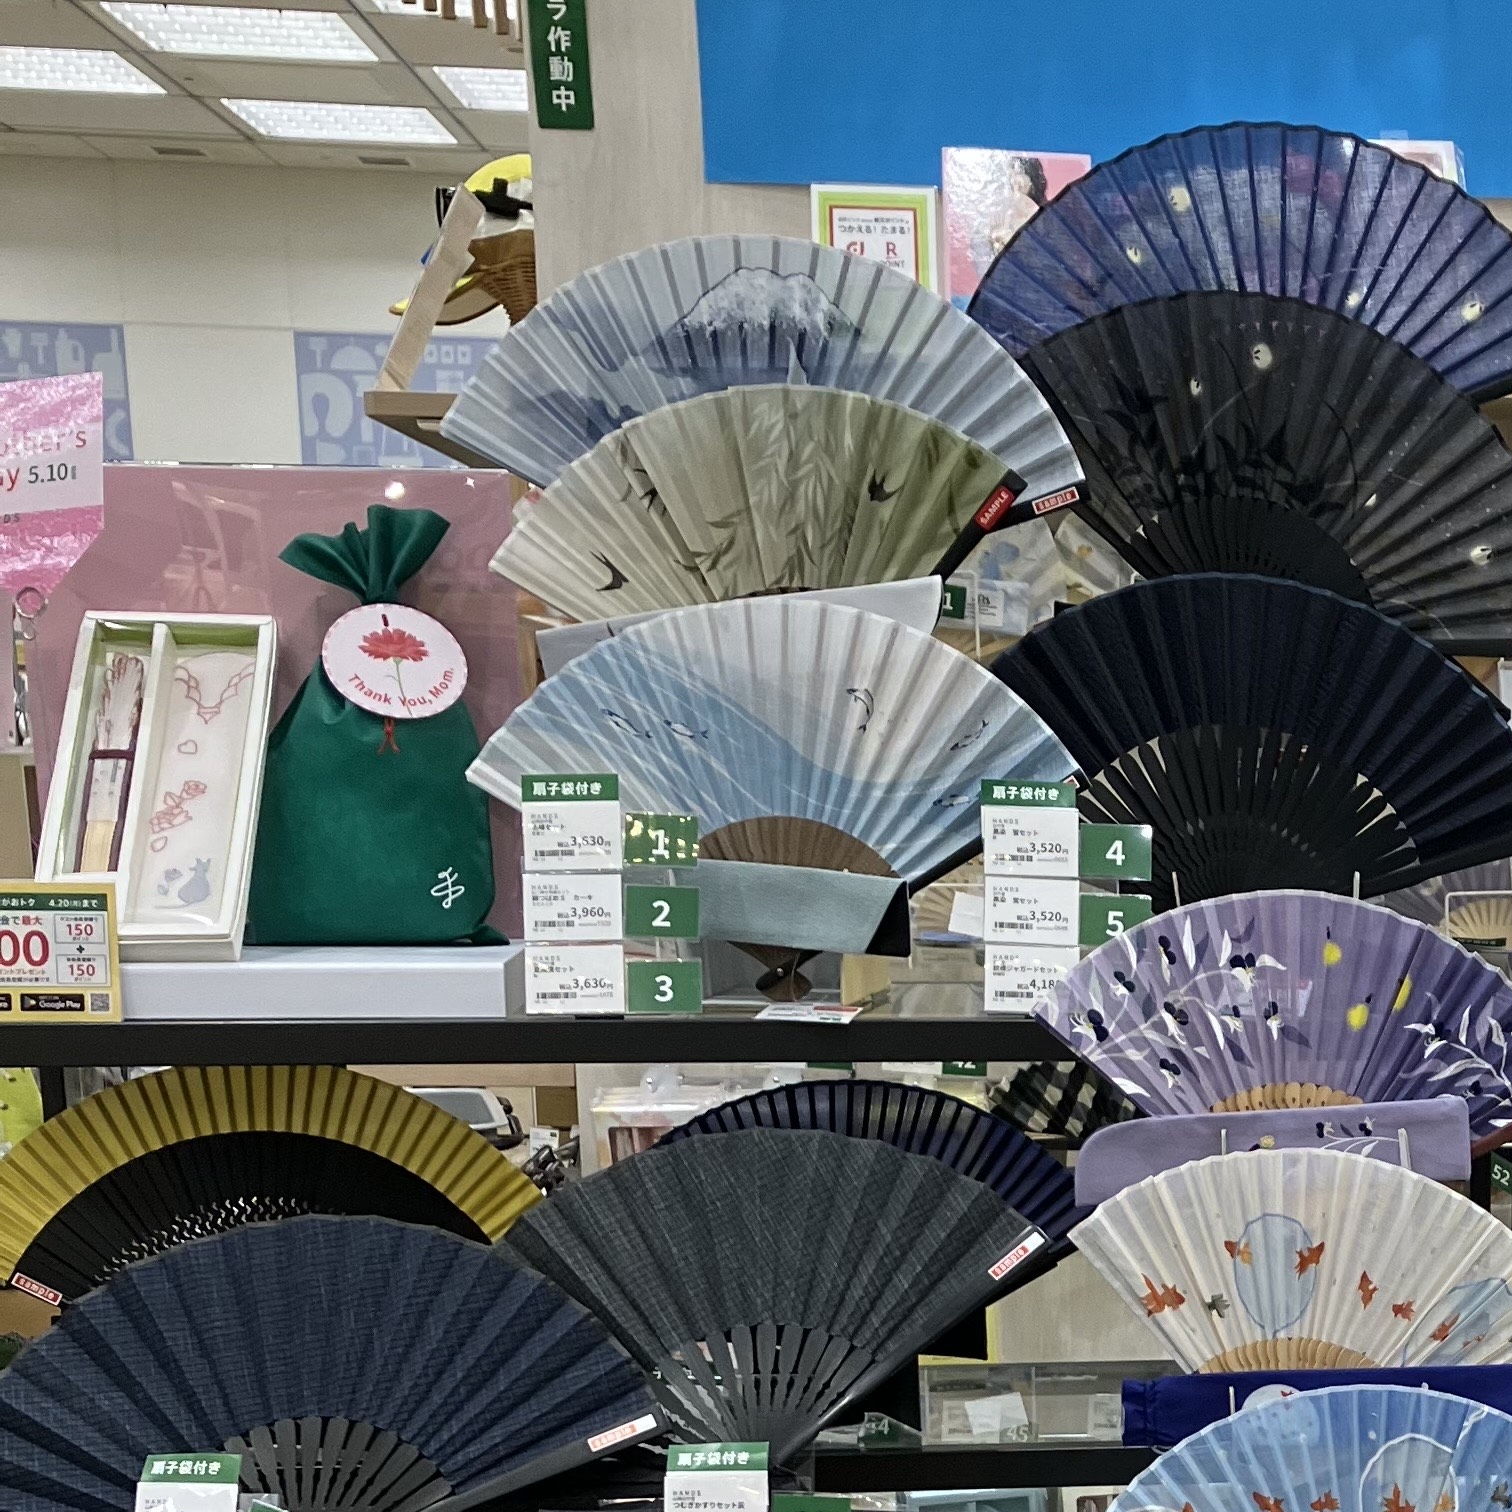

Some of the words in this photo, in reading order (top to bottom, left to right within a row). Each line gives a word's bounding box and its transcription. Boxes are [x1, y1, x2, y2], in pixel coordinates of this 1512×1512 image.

[980, 490, 1009, 524] SAMPLE
[349, 673, 392, 705] Thank
[429, 667, 455, 699] Mom.
[651, 829, 668, 856] 1
[1105, 840, 1126, 866] 4
[651, 900, 671, 927] 2
[1105, 911, 1125, 937] 5
[66, 924, 94, 936] 150
[69, 964, 96, 976] 150
[654, 975, 673, 1002] 3
[1492, 1164, 1510, 1186] 52
